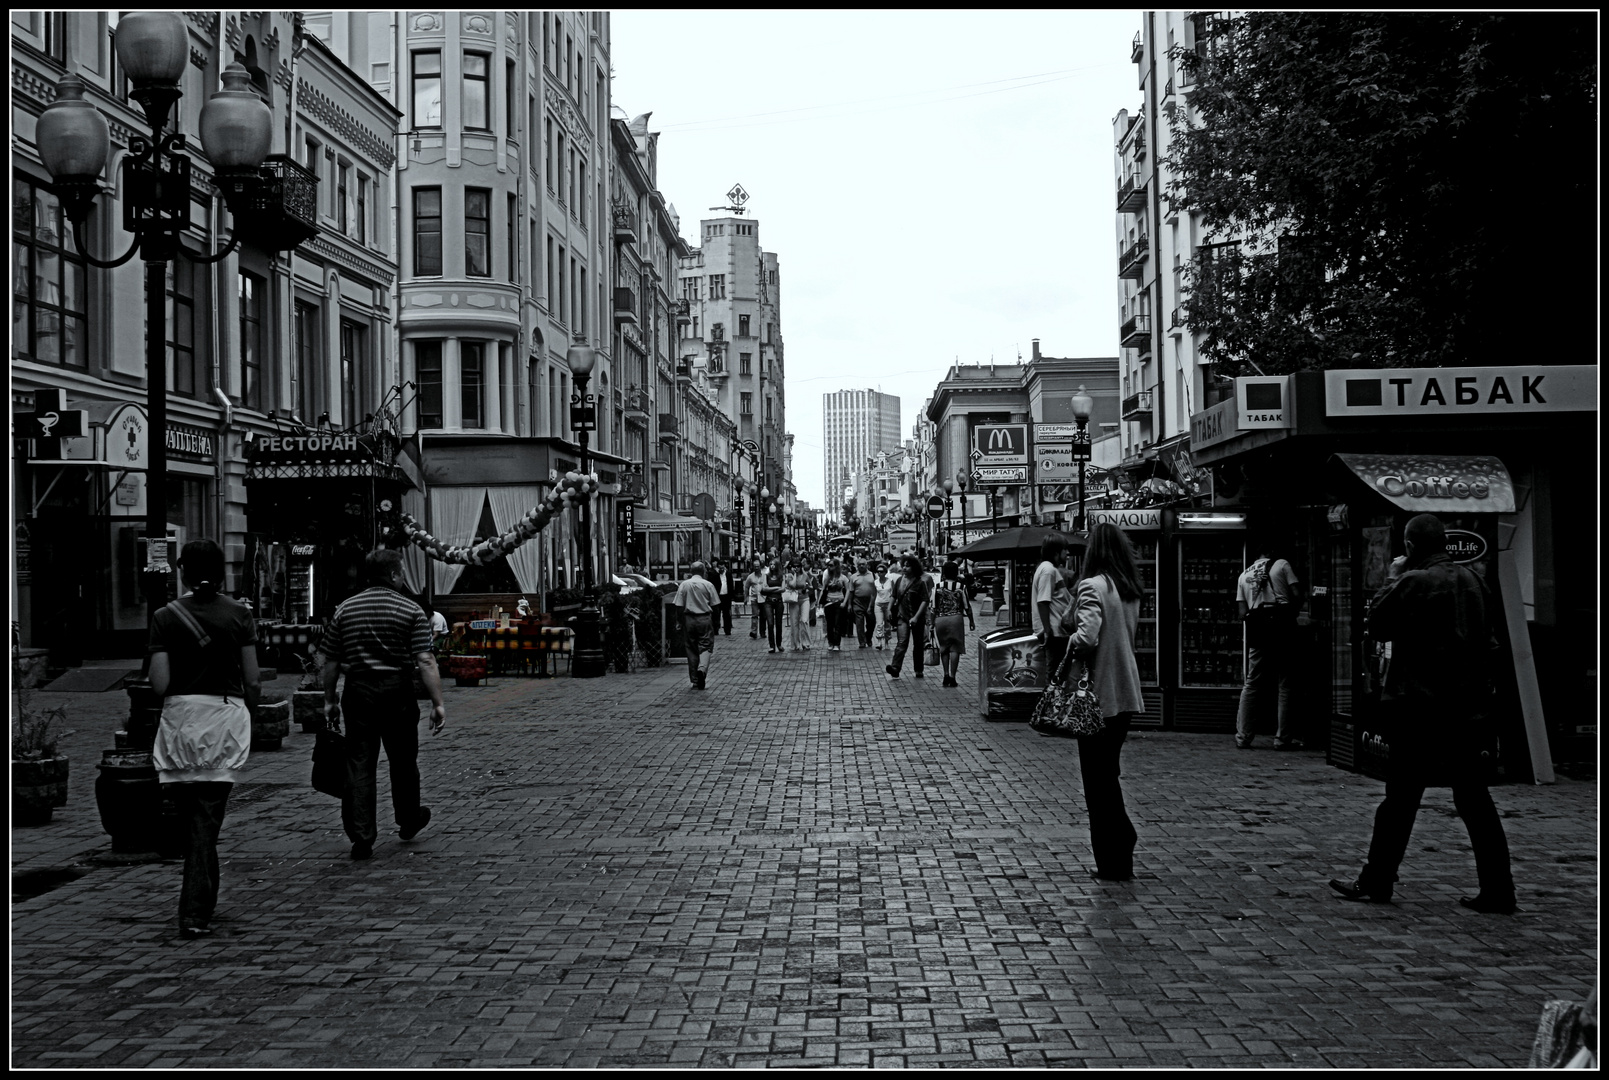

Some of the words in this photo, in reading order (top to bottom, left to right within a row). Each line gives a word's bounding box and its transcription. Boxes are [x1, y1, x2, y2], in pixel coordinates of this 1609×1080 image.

[1389, 376, 1547, 407] ТАБАК
[1247, 414, 1283, 423] ТАБАК
[1197, 412, 1223, 442] ТАБАК
[259, 436, 357, 452] РЕСТОРАН
[1376, 475, 1490, 499] Coffee
[1089, 514, 1159, 527] BONAQUA
[291, 545, 315, 556] Coca-Cola
[1445, 541, 1478, 551] onLife
[471, 621, 496, 629] АПТЕКА
[1361, 730, 1389, 759] Coffee
